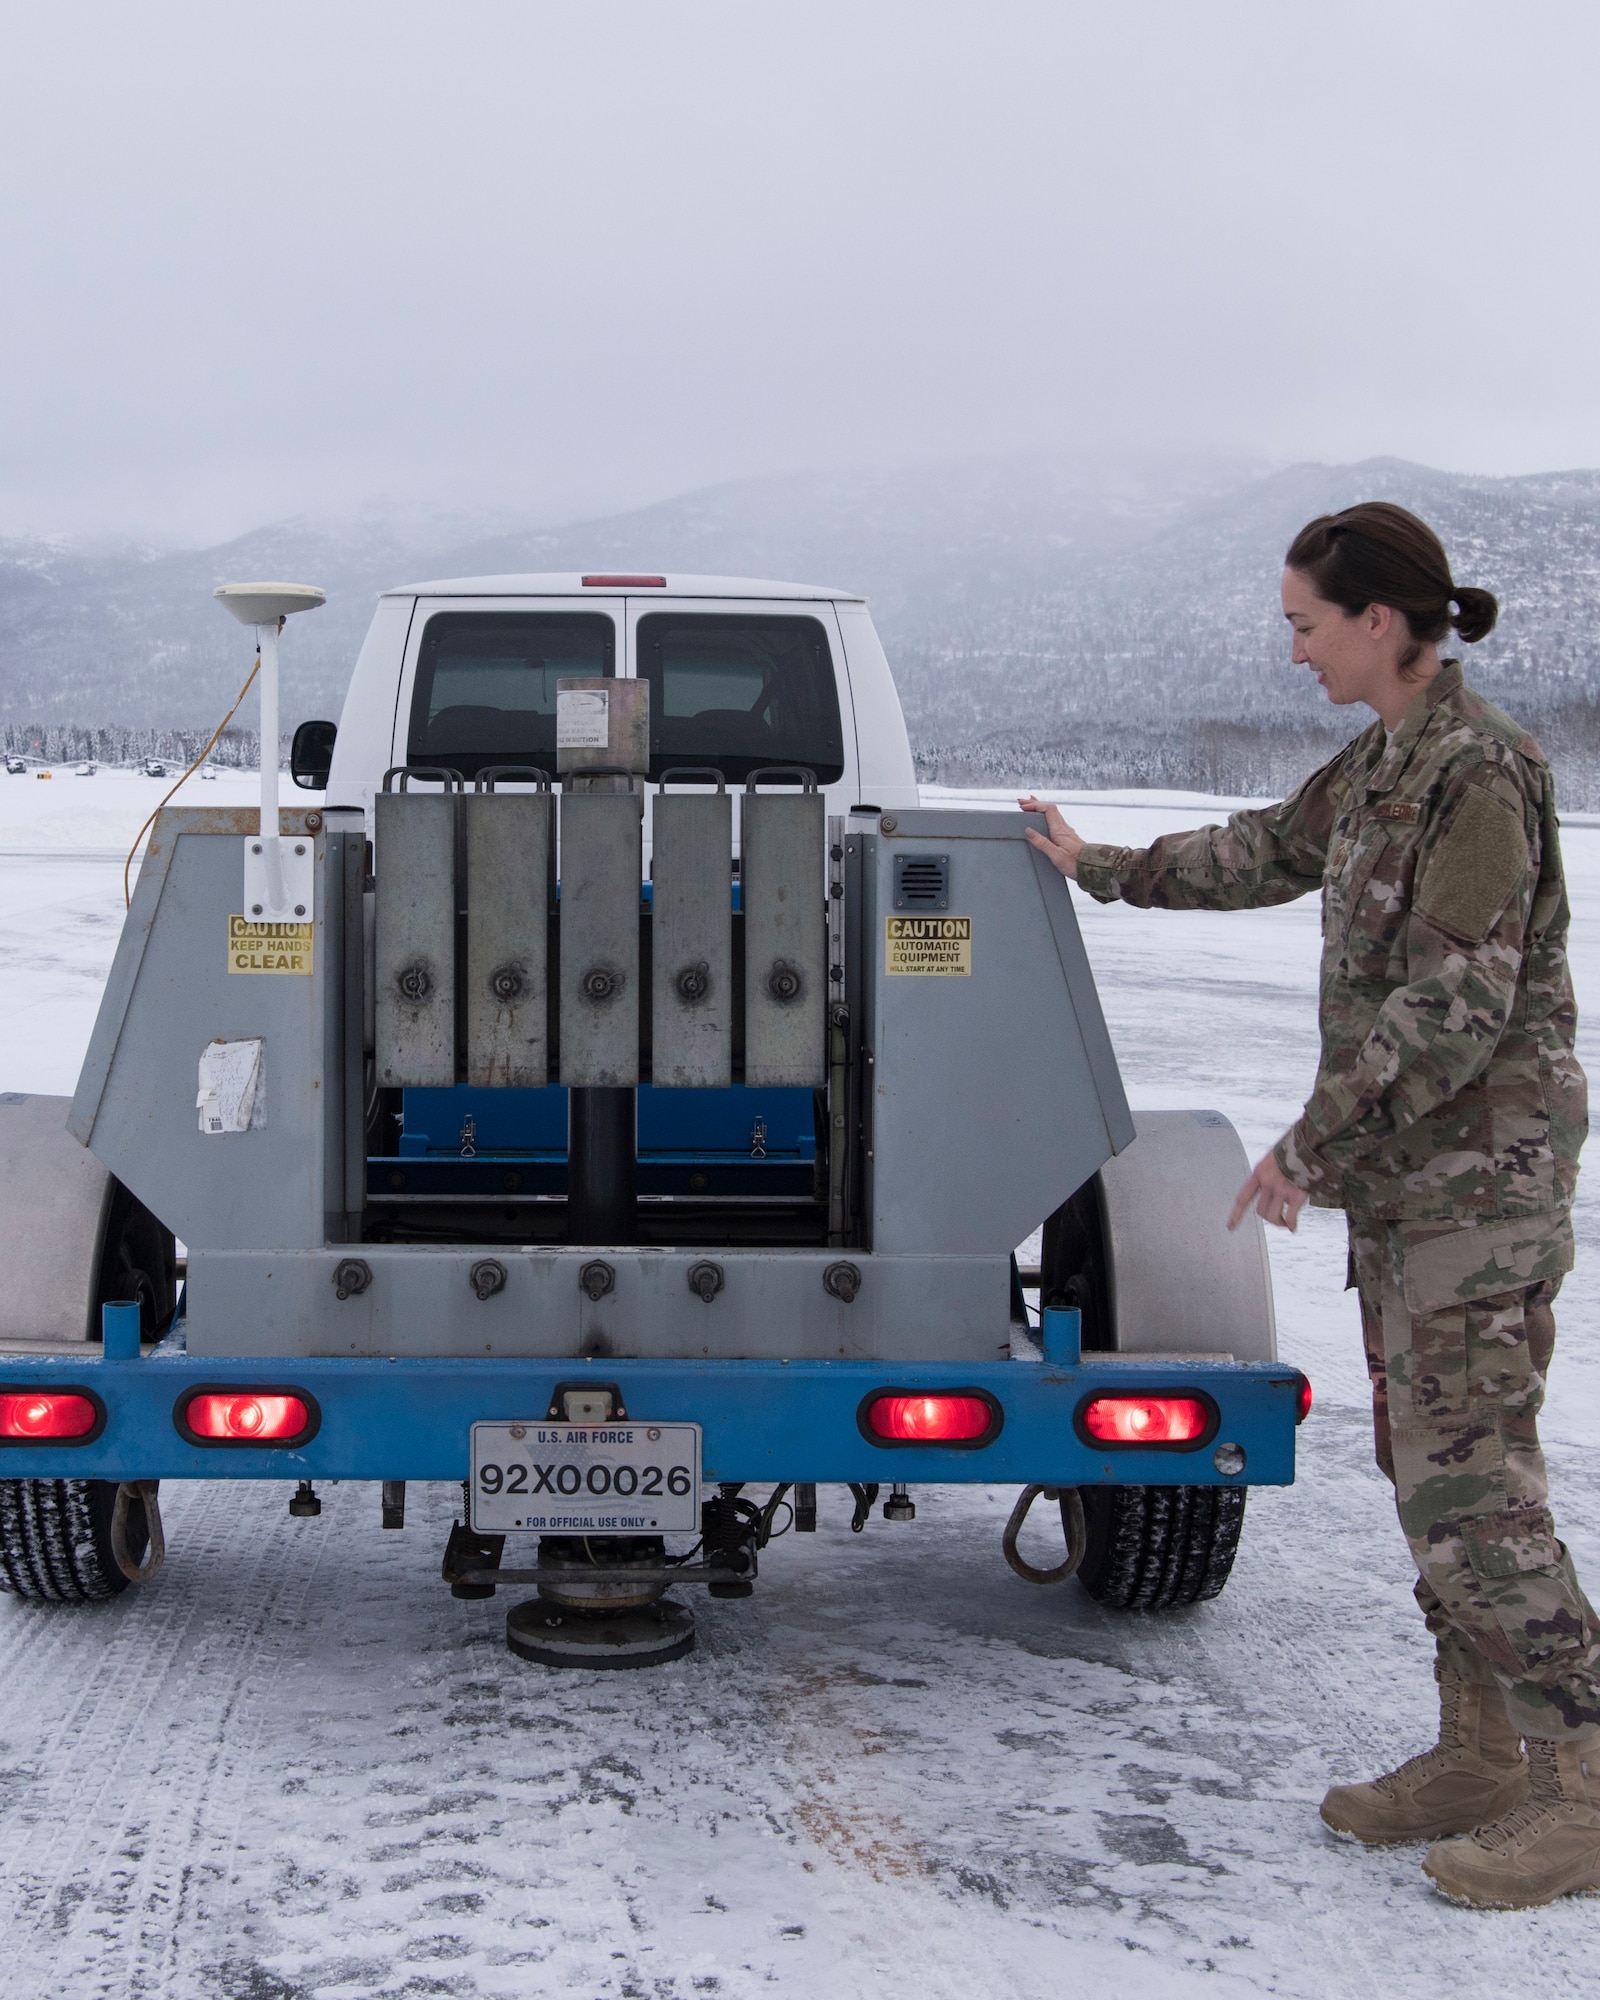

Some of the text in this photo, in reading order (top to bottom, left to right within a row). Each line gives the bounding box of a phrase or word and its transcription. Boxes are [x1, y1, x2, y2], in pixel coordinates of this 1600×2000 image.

[233, 918, 311, 937] CAUTION
[890, 920, 968, 938] CAUTION
[231, 940, 311, 952] KEEP HANDS
[893, 941, 960, 951] AUTOMATIC
[235, 954, 304, 969] CLEAR
[893, 953, 961, 963] EQUIPMENT
[538, 1431, 634, 1443] U.S. AIR FORCE
[526, 1517, 645, 1528] FOR OFFICIAL USE ONLY
